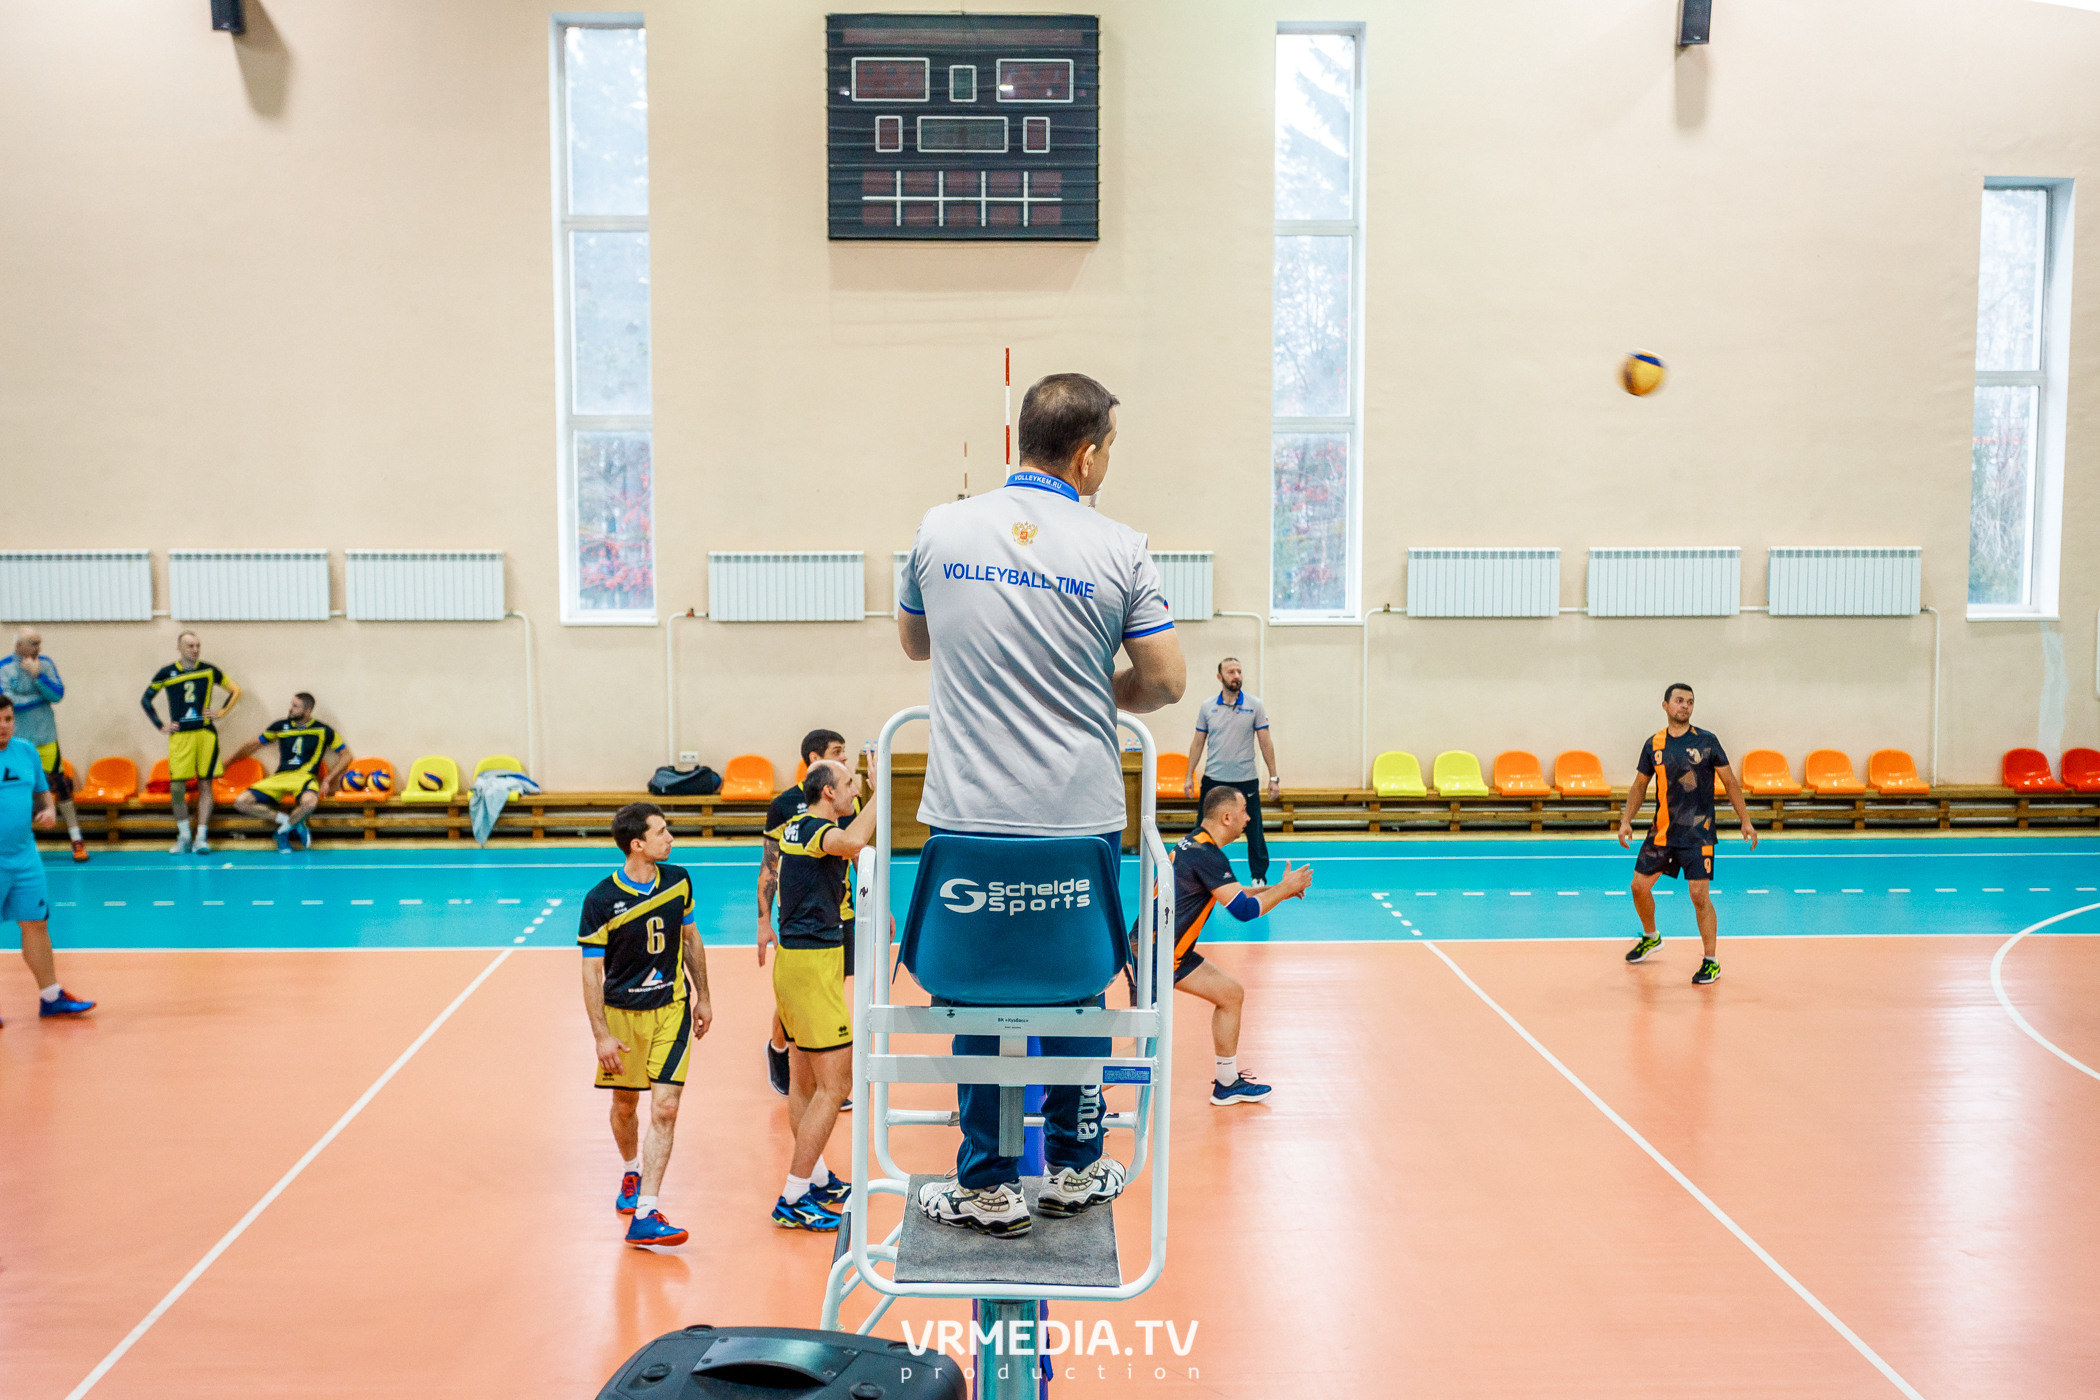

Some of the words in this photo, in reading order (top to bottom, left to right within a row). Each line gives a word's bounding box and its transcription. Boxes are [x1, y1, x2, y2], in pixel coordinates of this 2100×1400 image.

[1014, 474, 1062, 489] VOLLEYKEM.RU
[943, 563, 1052, 589] VOLLEYBALL
[1055, 576, 1095, 599] TIME
[184, 681, 195, 703] 2
[292, 736, 302, 755] 4
[1654, 750, 1662, 765] 9
[988, 878, 1090, 896] Schelde
[988, 894, 1091, 916] Sports
[646, 916, 665, 954] 6
[1077, 1085, 1100, 1142] oma
